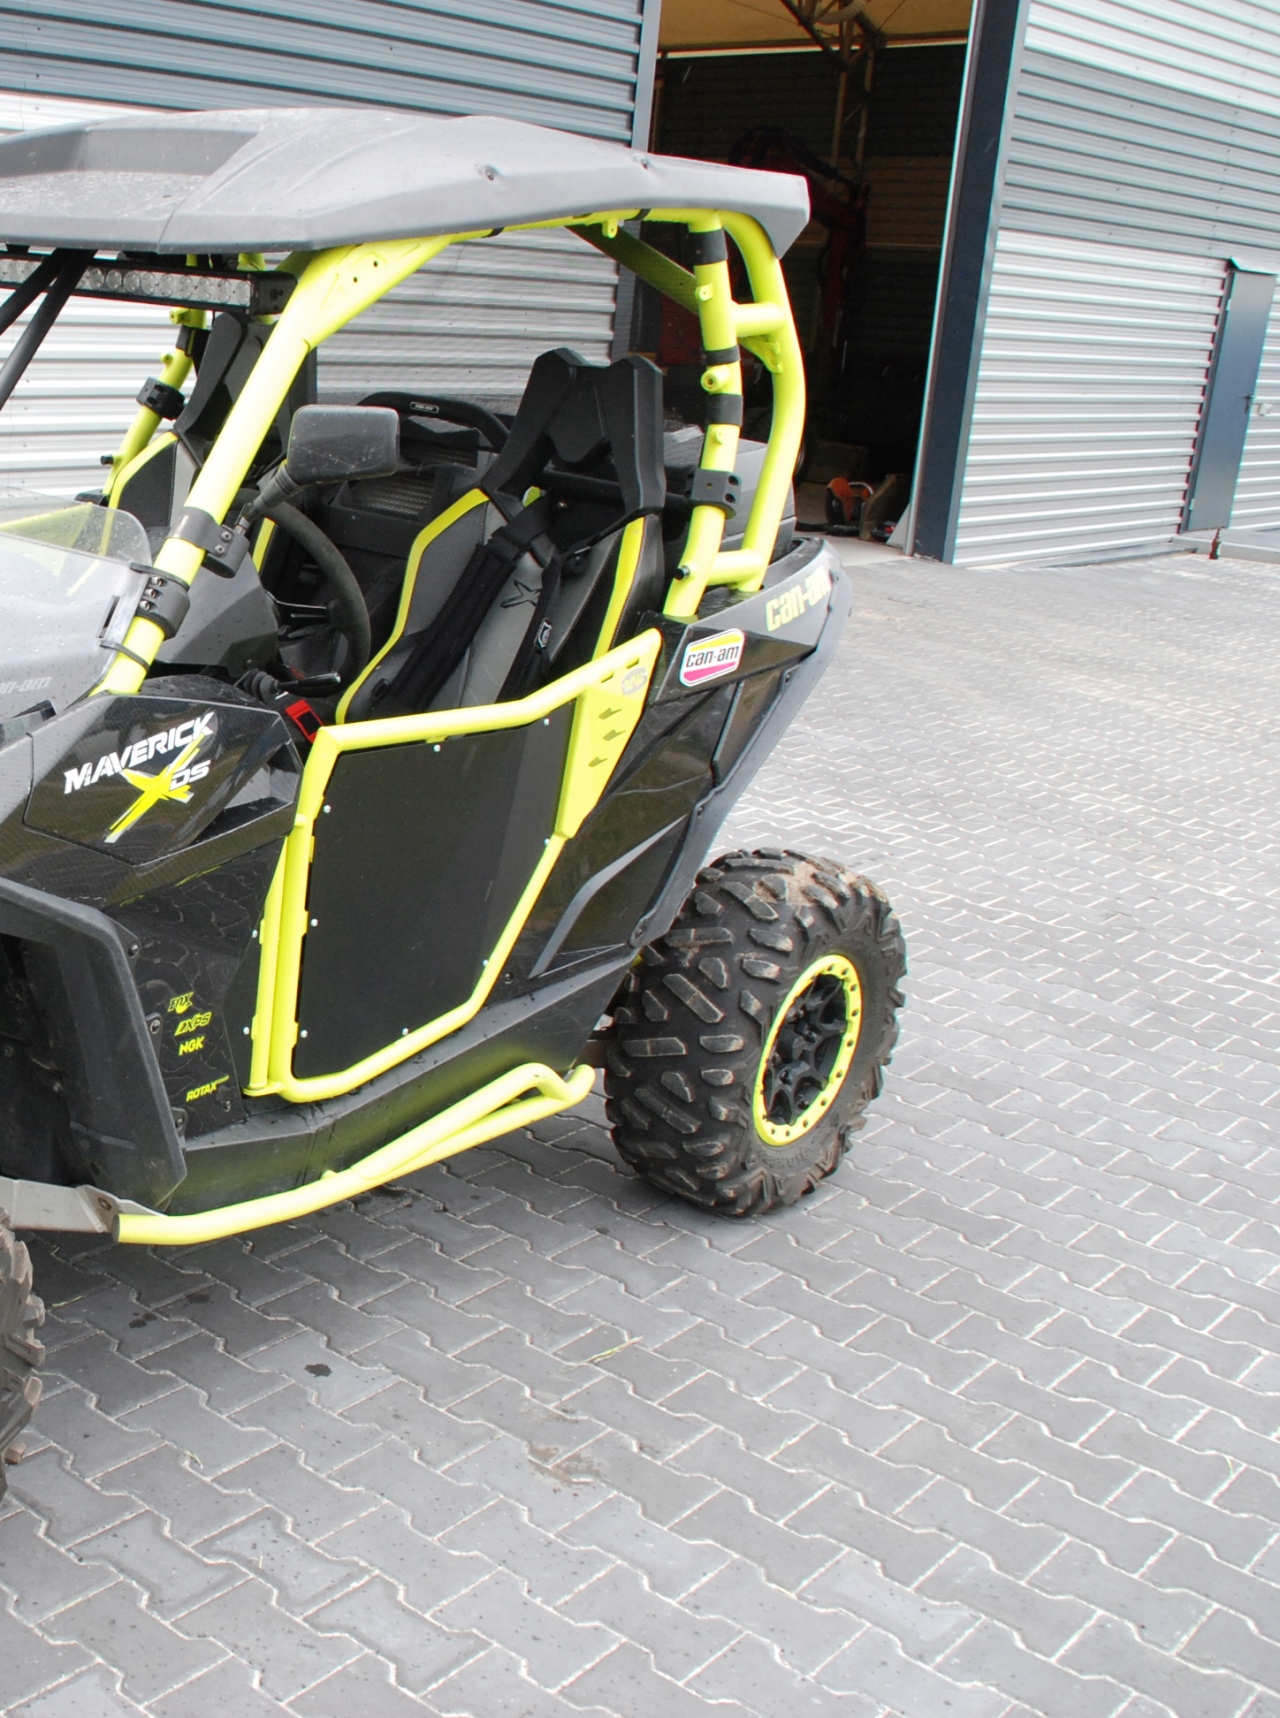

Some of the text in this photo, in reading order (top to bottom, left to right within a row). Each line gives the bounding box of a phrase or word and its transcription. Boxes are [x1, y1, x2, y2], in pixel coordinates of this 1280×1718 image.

[765, 564, 832, 632] can-am
[685, 645, 739, 668] can-am
[64, 711, 214, 795] MAVERICK
[178, 1035, 205, 1056] NGK
[185, 1081, 219, 1103] ROTAX
